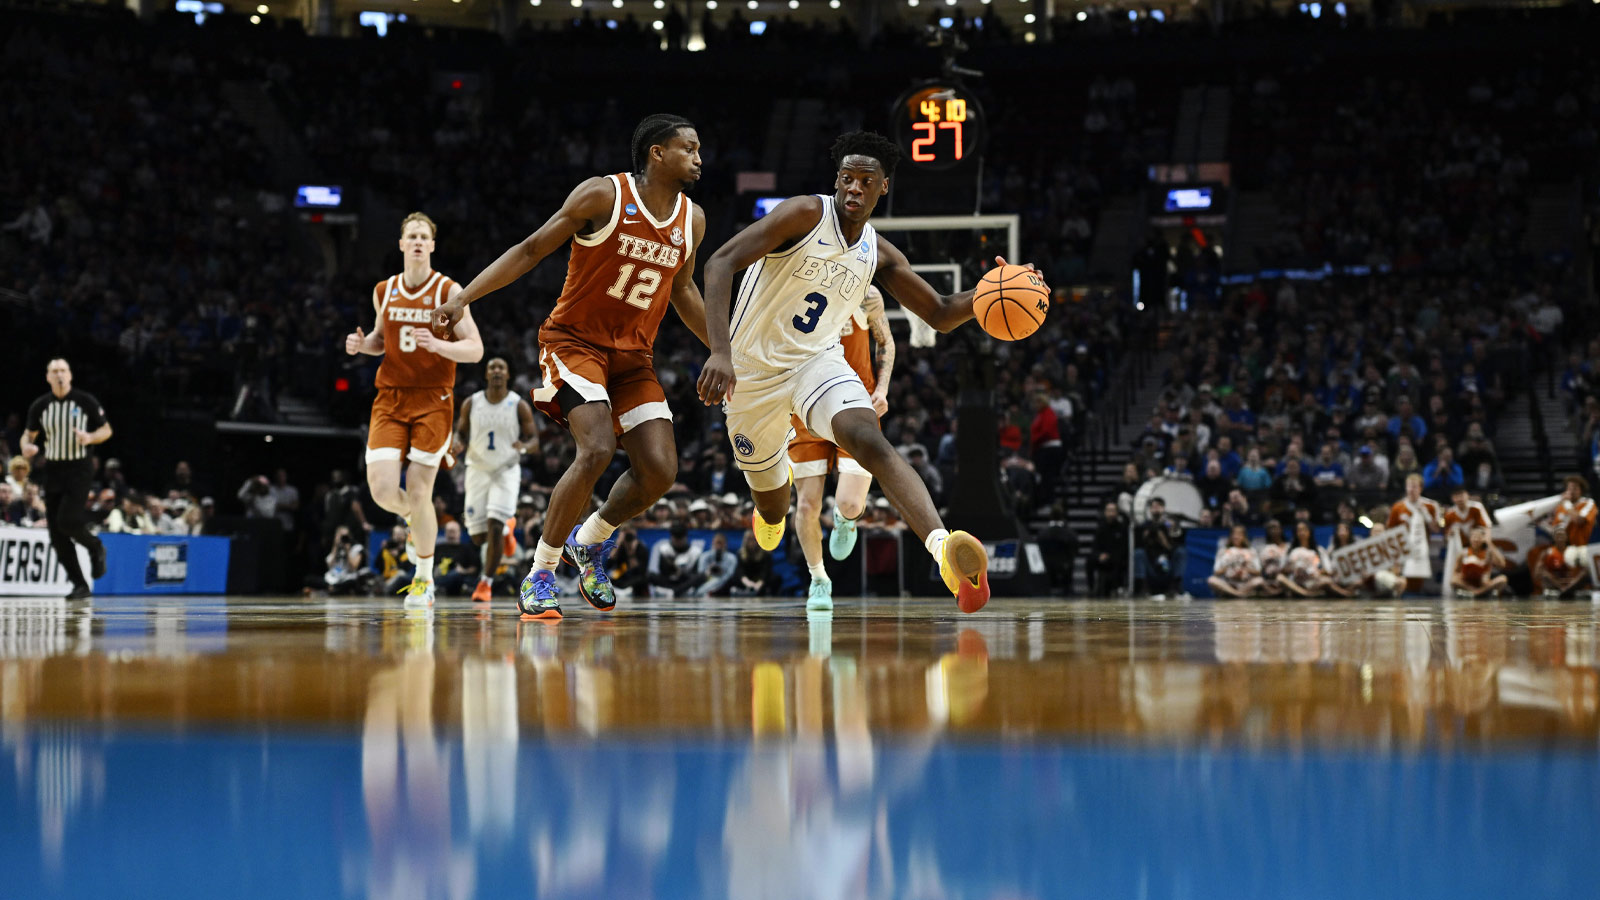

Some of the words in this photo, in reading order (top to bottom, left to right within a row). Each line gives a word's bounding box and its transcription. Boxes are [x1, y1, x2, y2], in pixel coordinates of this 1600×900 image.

[920, 99, 967, 122] 4:10
[912, 121, 963, 162] 27
[617, 233, 682, 268] TEXAS
[606, 262, 663, 310] 12
[792, 255, 862, 301] BYU
[388, 306, 433, 324] TEXAS
[791, 291, 829, 334] 3
[487, 431, 496, 451] 1
[0, 539, 69, 583] ERSI
[1337, 533, 1410, 577] DEFENSE
